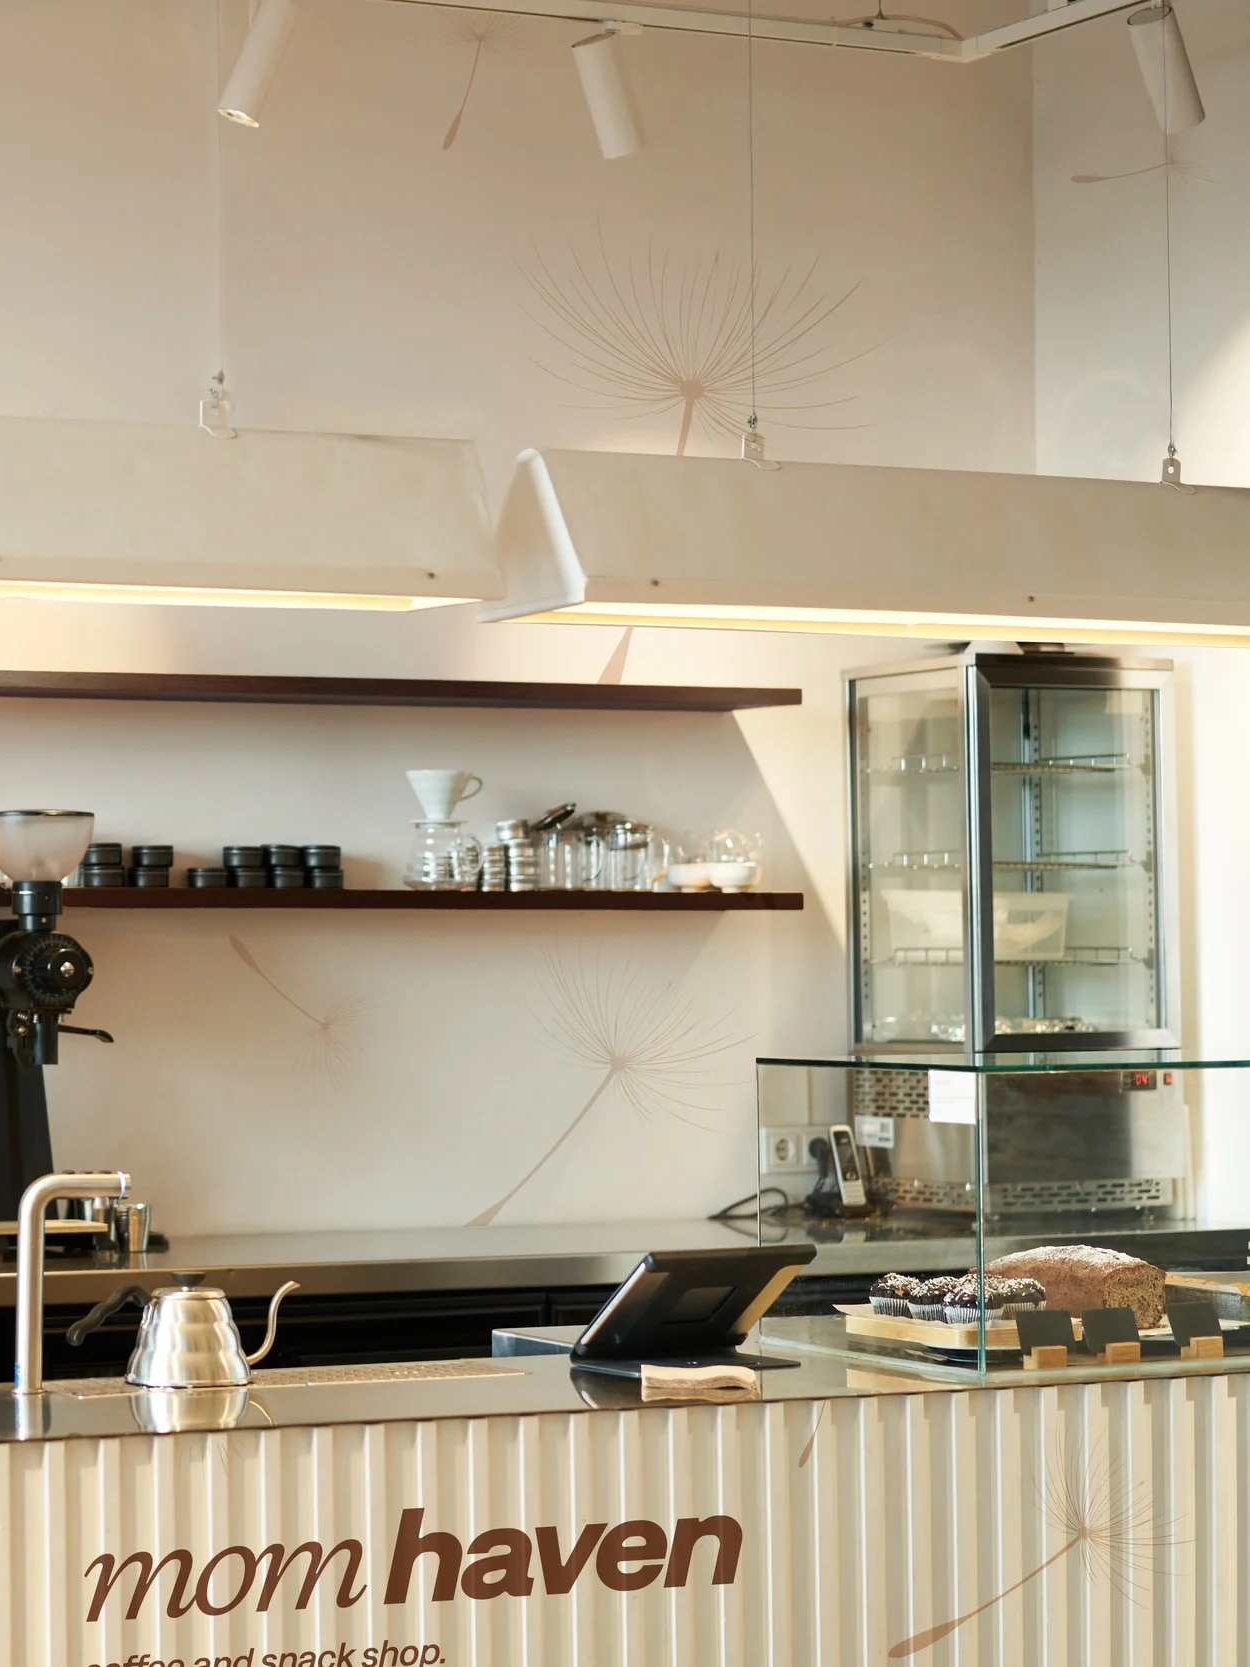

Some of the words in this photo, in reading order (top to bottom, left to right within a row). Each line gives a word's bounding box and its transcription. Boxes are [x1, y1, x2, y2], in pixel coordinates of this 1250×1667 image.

[83, 1538, 368, 1623] mom
[383, 1507, 743, 1605] haven
[261, 1643, 356, 1667] snack
[361, 1639, 446, 1667] shop.
